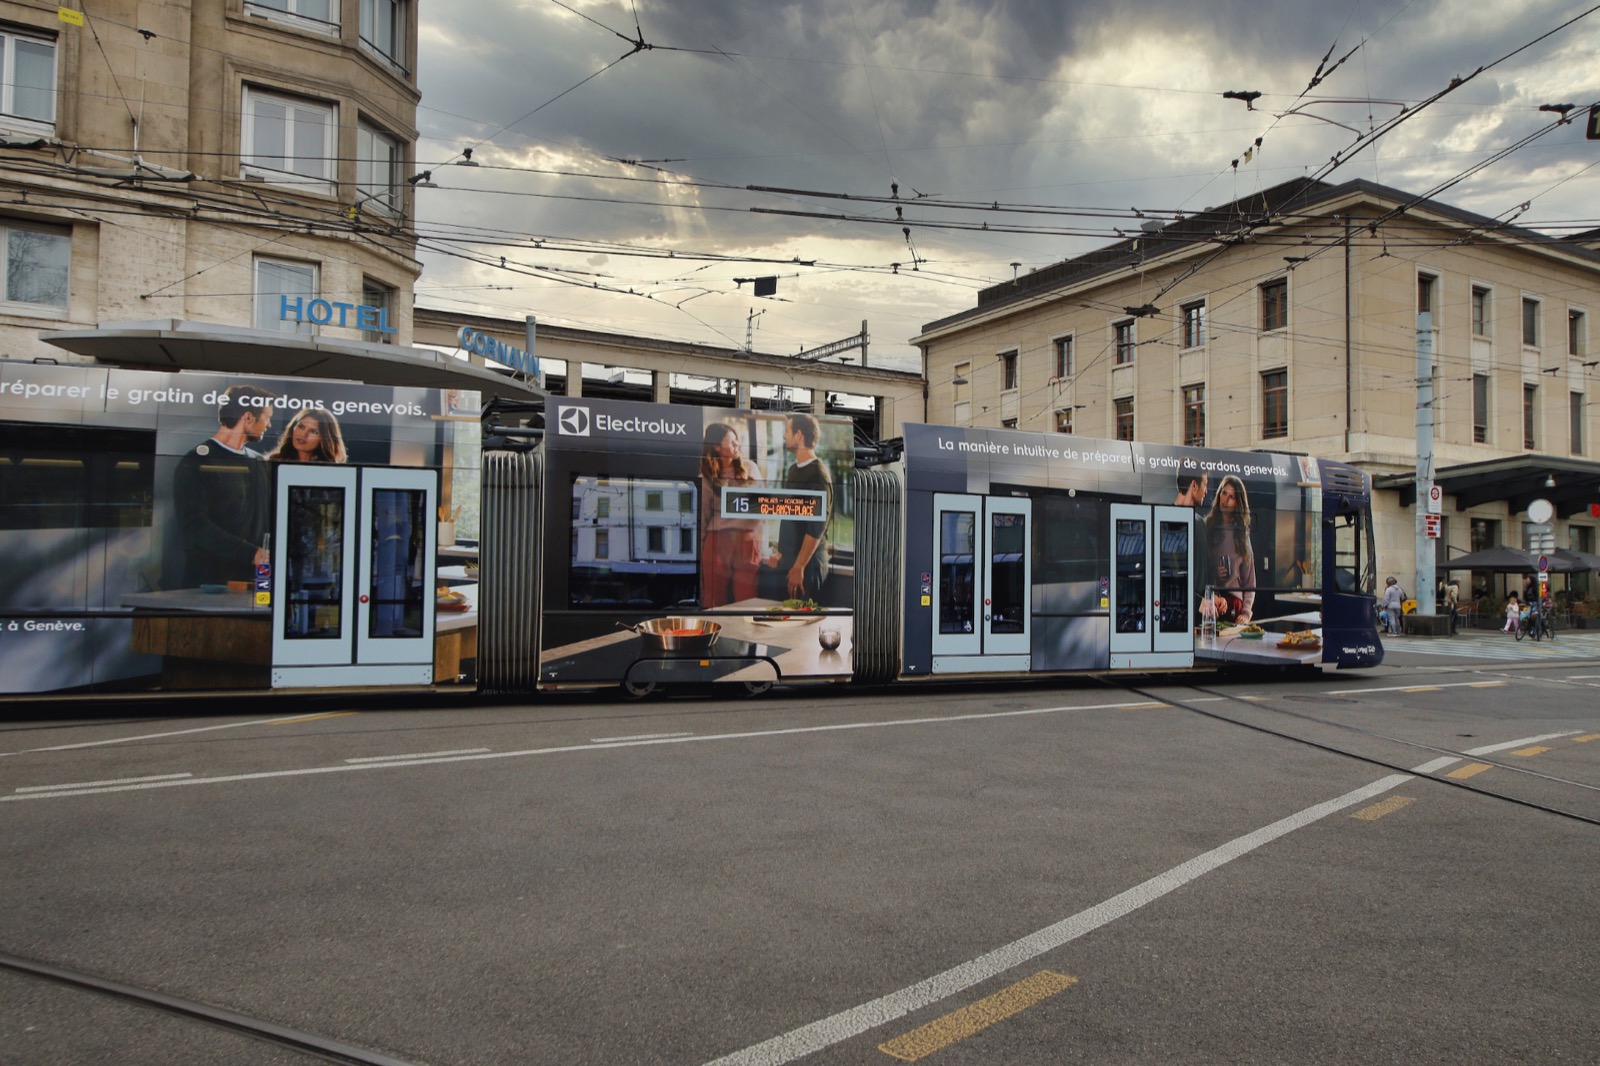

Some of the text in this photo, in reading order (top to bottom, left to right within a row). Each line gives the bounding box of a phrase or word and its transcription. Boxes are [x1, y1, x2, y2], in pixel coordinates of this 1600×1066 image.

[280, 294, 398, 334] HOTEL
[459, 326, 540, 377] CORNAVIN
[100, 384, 119, 400] le
[128, 387, 194, 405] gratin
[202, 390, 230, 405] de
[238, 394, 324, 411] cardons
[332, 400, 427, 416] genevois.
[596, 414, 687, 435] Electrolux
[938, 437, 1289, 477] La manière intuitive de préparer le gratin de cardons genevois.
[733, 497, 749, 512] 15
[7, 620, 19, 631] à
[23, 620, 86, 631] Genève.
